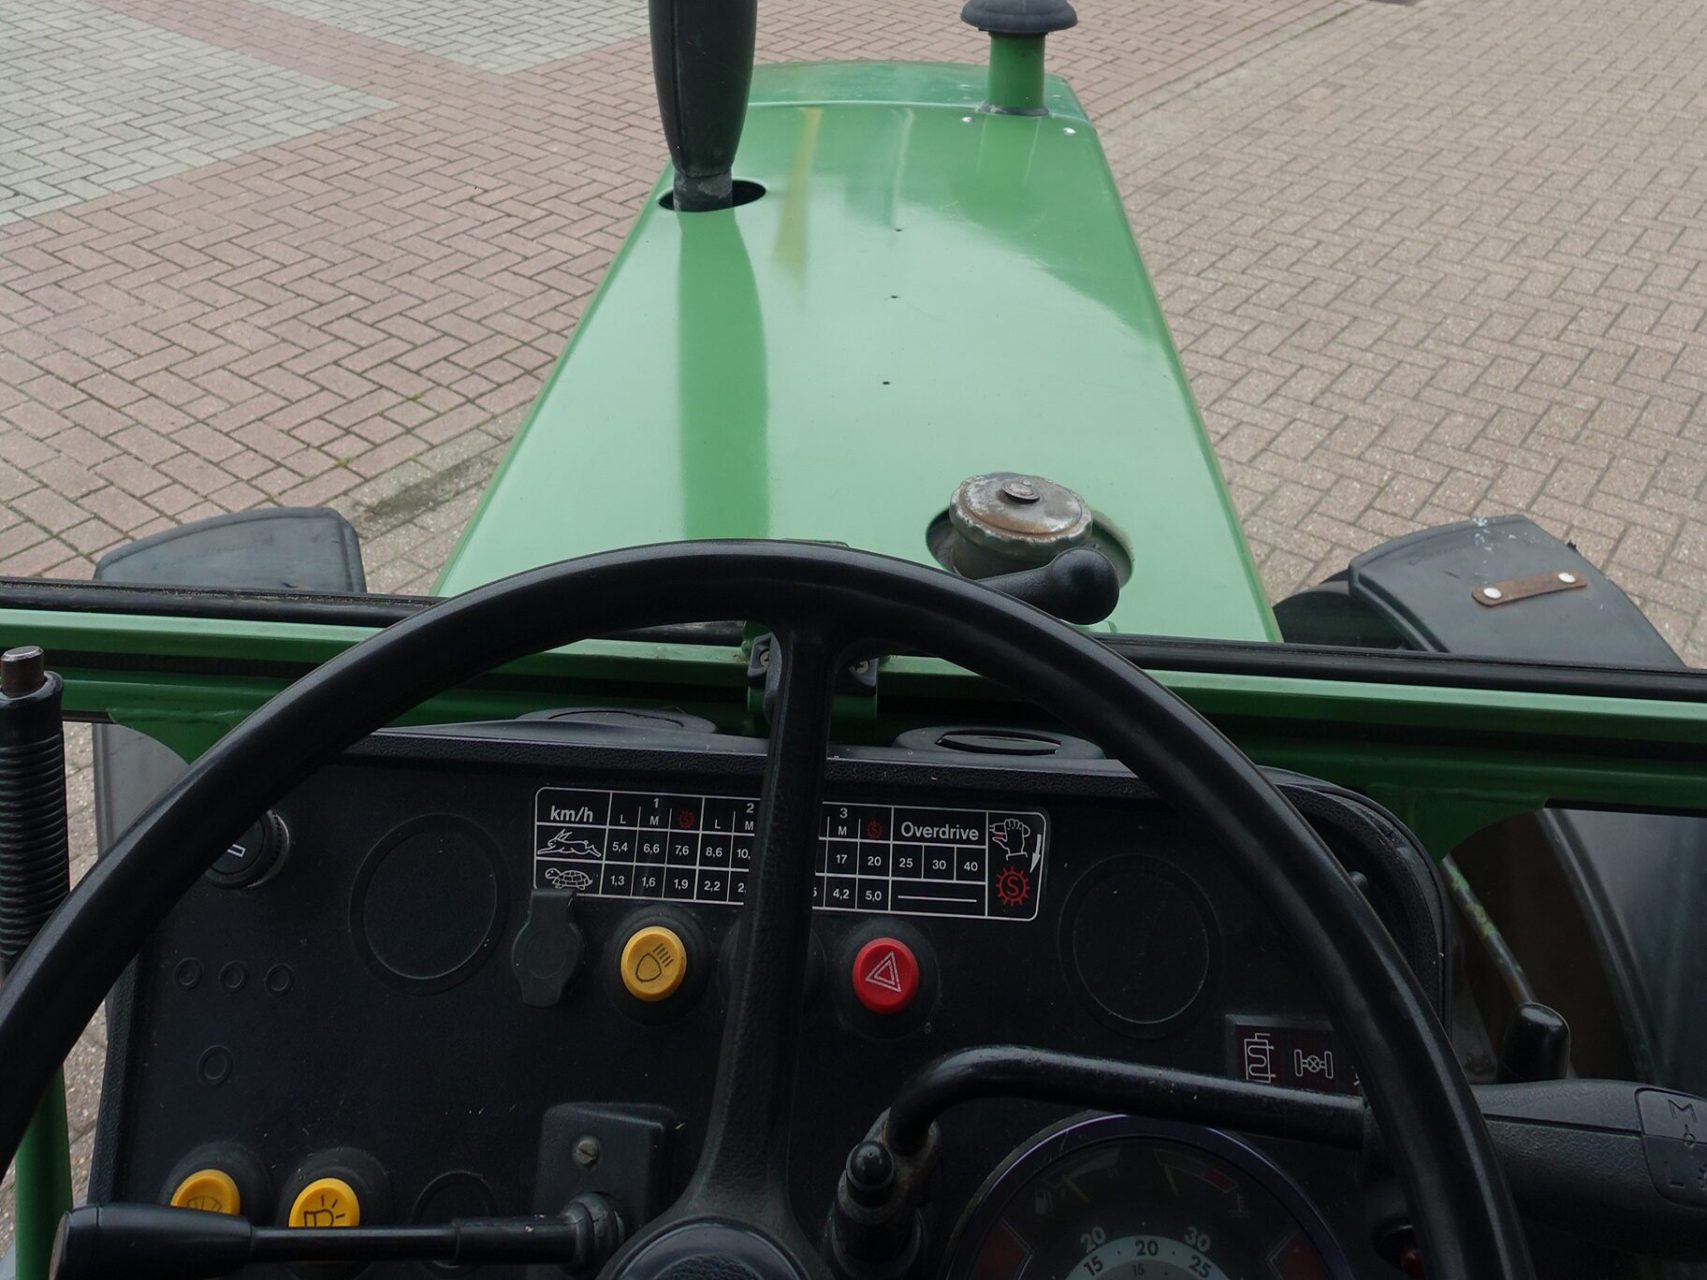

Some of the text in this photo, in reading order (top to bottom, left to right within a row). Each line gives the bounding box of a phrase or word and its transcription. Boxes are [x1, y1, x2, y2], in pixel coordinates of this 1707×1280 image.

[549, 798, 980, 841] km/h 1 2 3 Overdrive
[619, 814, 627, 825] L
[649, 815, 660, 826] M
[714, 819, 721, 830] L
[744, 820, 755, 831] M
[838, 825, 848, 836] M
[612, 841, 979, 872] 5,4 6,6 7,6 8,6 10, 17 20 25 30 40
[610, 873, 625, 886] 1,3
[641, 876, 656, 888] 1,6
[673, 878, 689, 891] 1,9
[704, 880, 721, 892] 2,2
[737, 882, 747, 894] 2,
[832, 888, 850, 900] 4,2
[865, 890, 883, 902] 5,0
[1080, 1226, 1212, 1253] 20 30
[1083, 1239, 1213, 1278] 15 20 25
